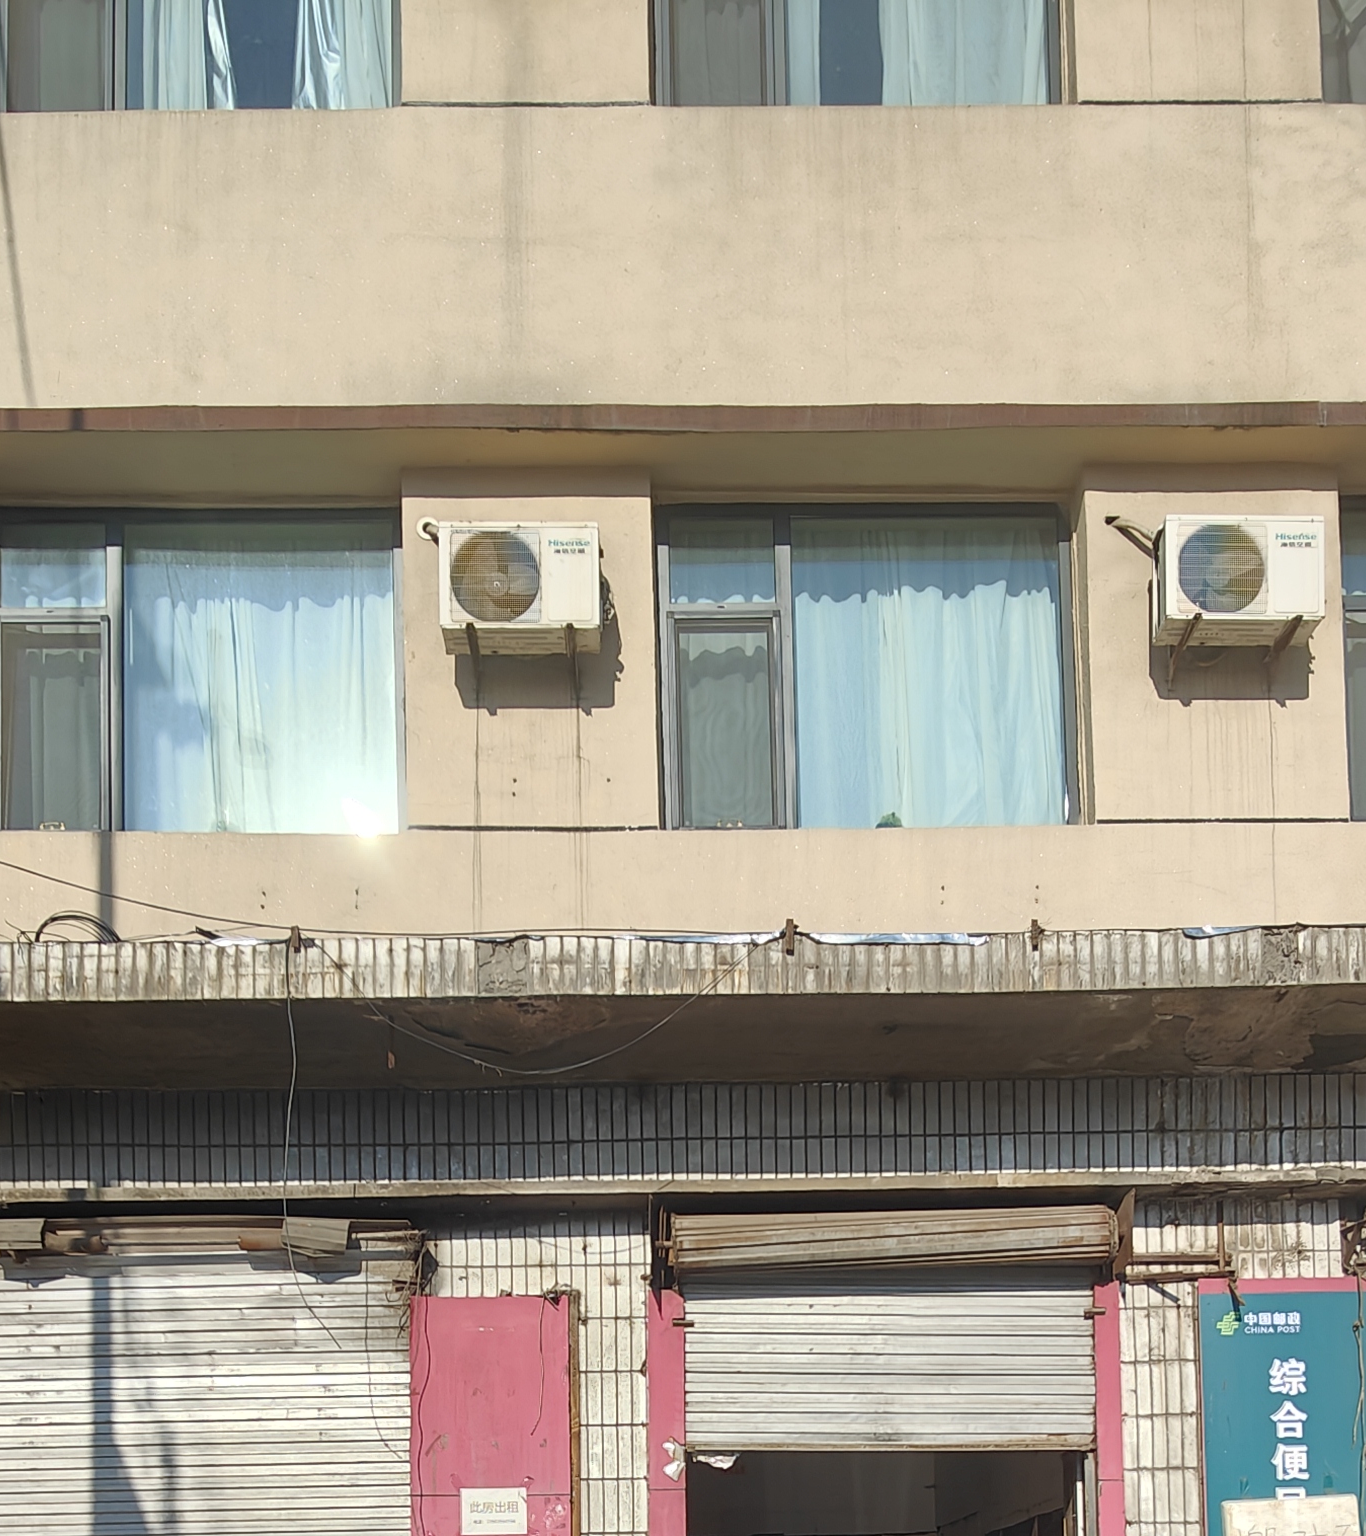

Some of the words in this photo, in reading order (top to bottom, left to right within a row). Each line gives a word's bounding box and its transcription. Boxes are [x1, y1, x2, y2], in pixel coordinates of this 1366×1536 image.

[1243, 1311, 1302, 1326] 中国邮政
[1243, 1325, 1275, 1334] CHINA
[1276, 1325, 1302, 1334] POST
[469, 1500, 520, 1514] 此房出租
